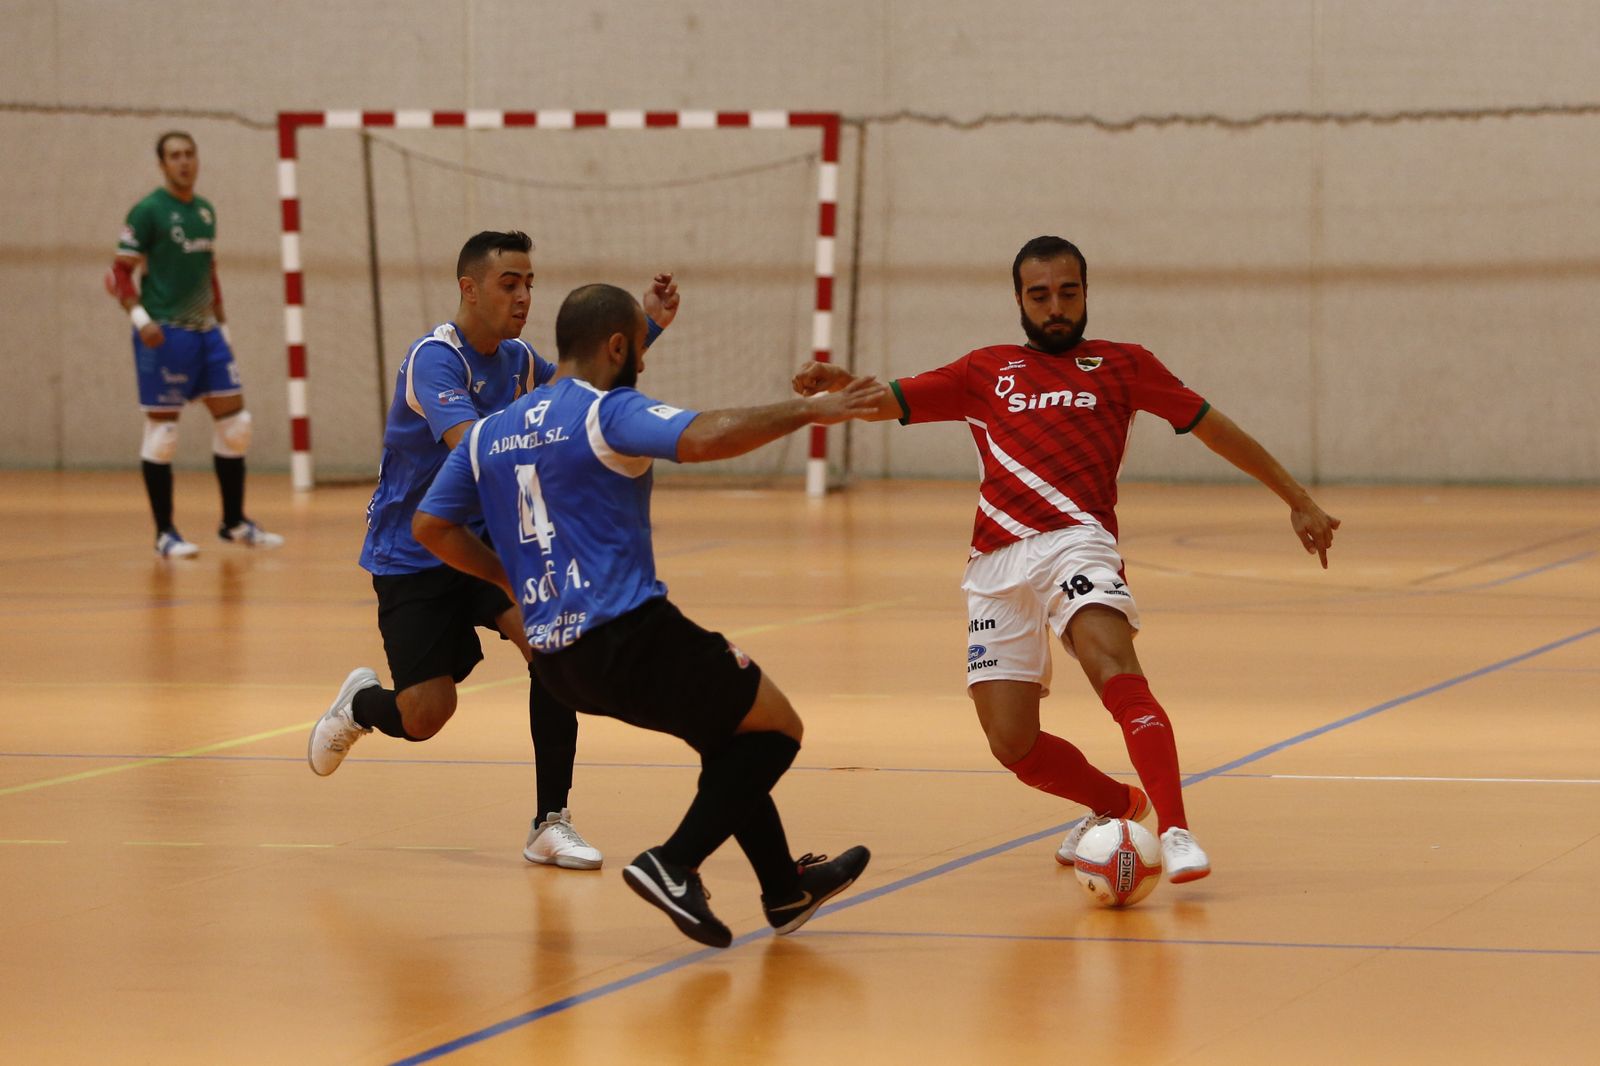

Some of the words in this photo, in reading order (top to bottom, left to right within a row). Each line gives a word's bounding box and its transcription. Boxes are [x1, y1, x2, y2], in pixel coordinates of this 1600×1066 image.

[1007, 390, 1097, 413] sima
[488, 431, 543, 456] ADIMEL
[514, 464, 556, 556] 4
[563, 557, 591, 590] A.
[1060, 574, 1094, 600] 18
[968, 618, 996, 637] ltin
[970, 658, 998, 671] Motor
[1119, 851, 1132, 892] MUNICH
